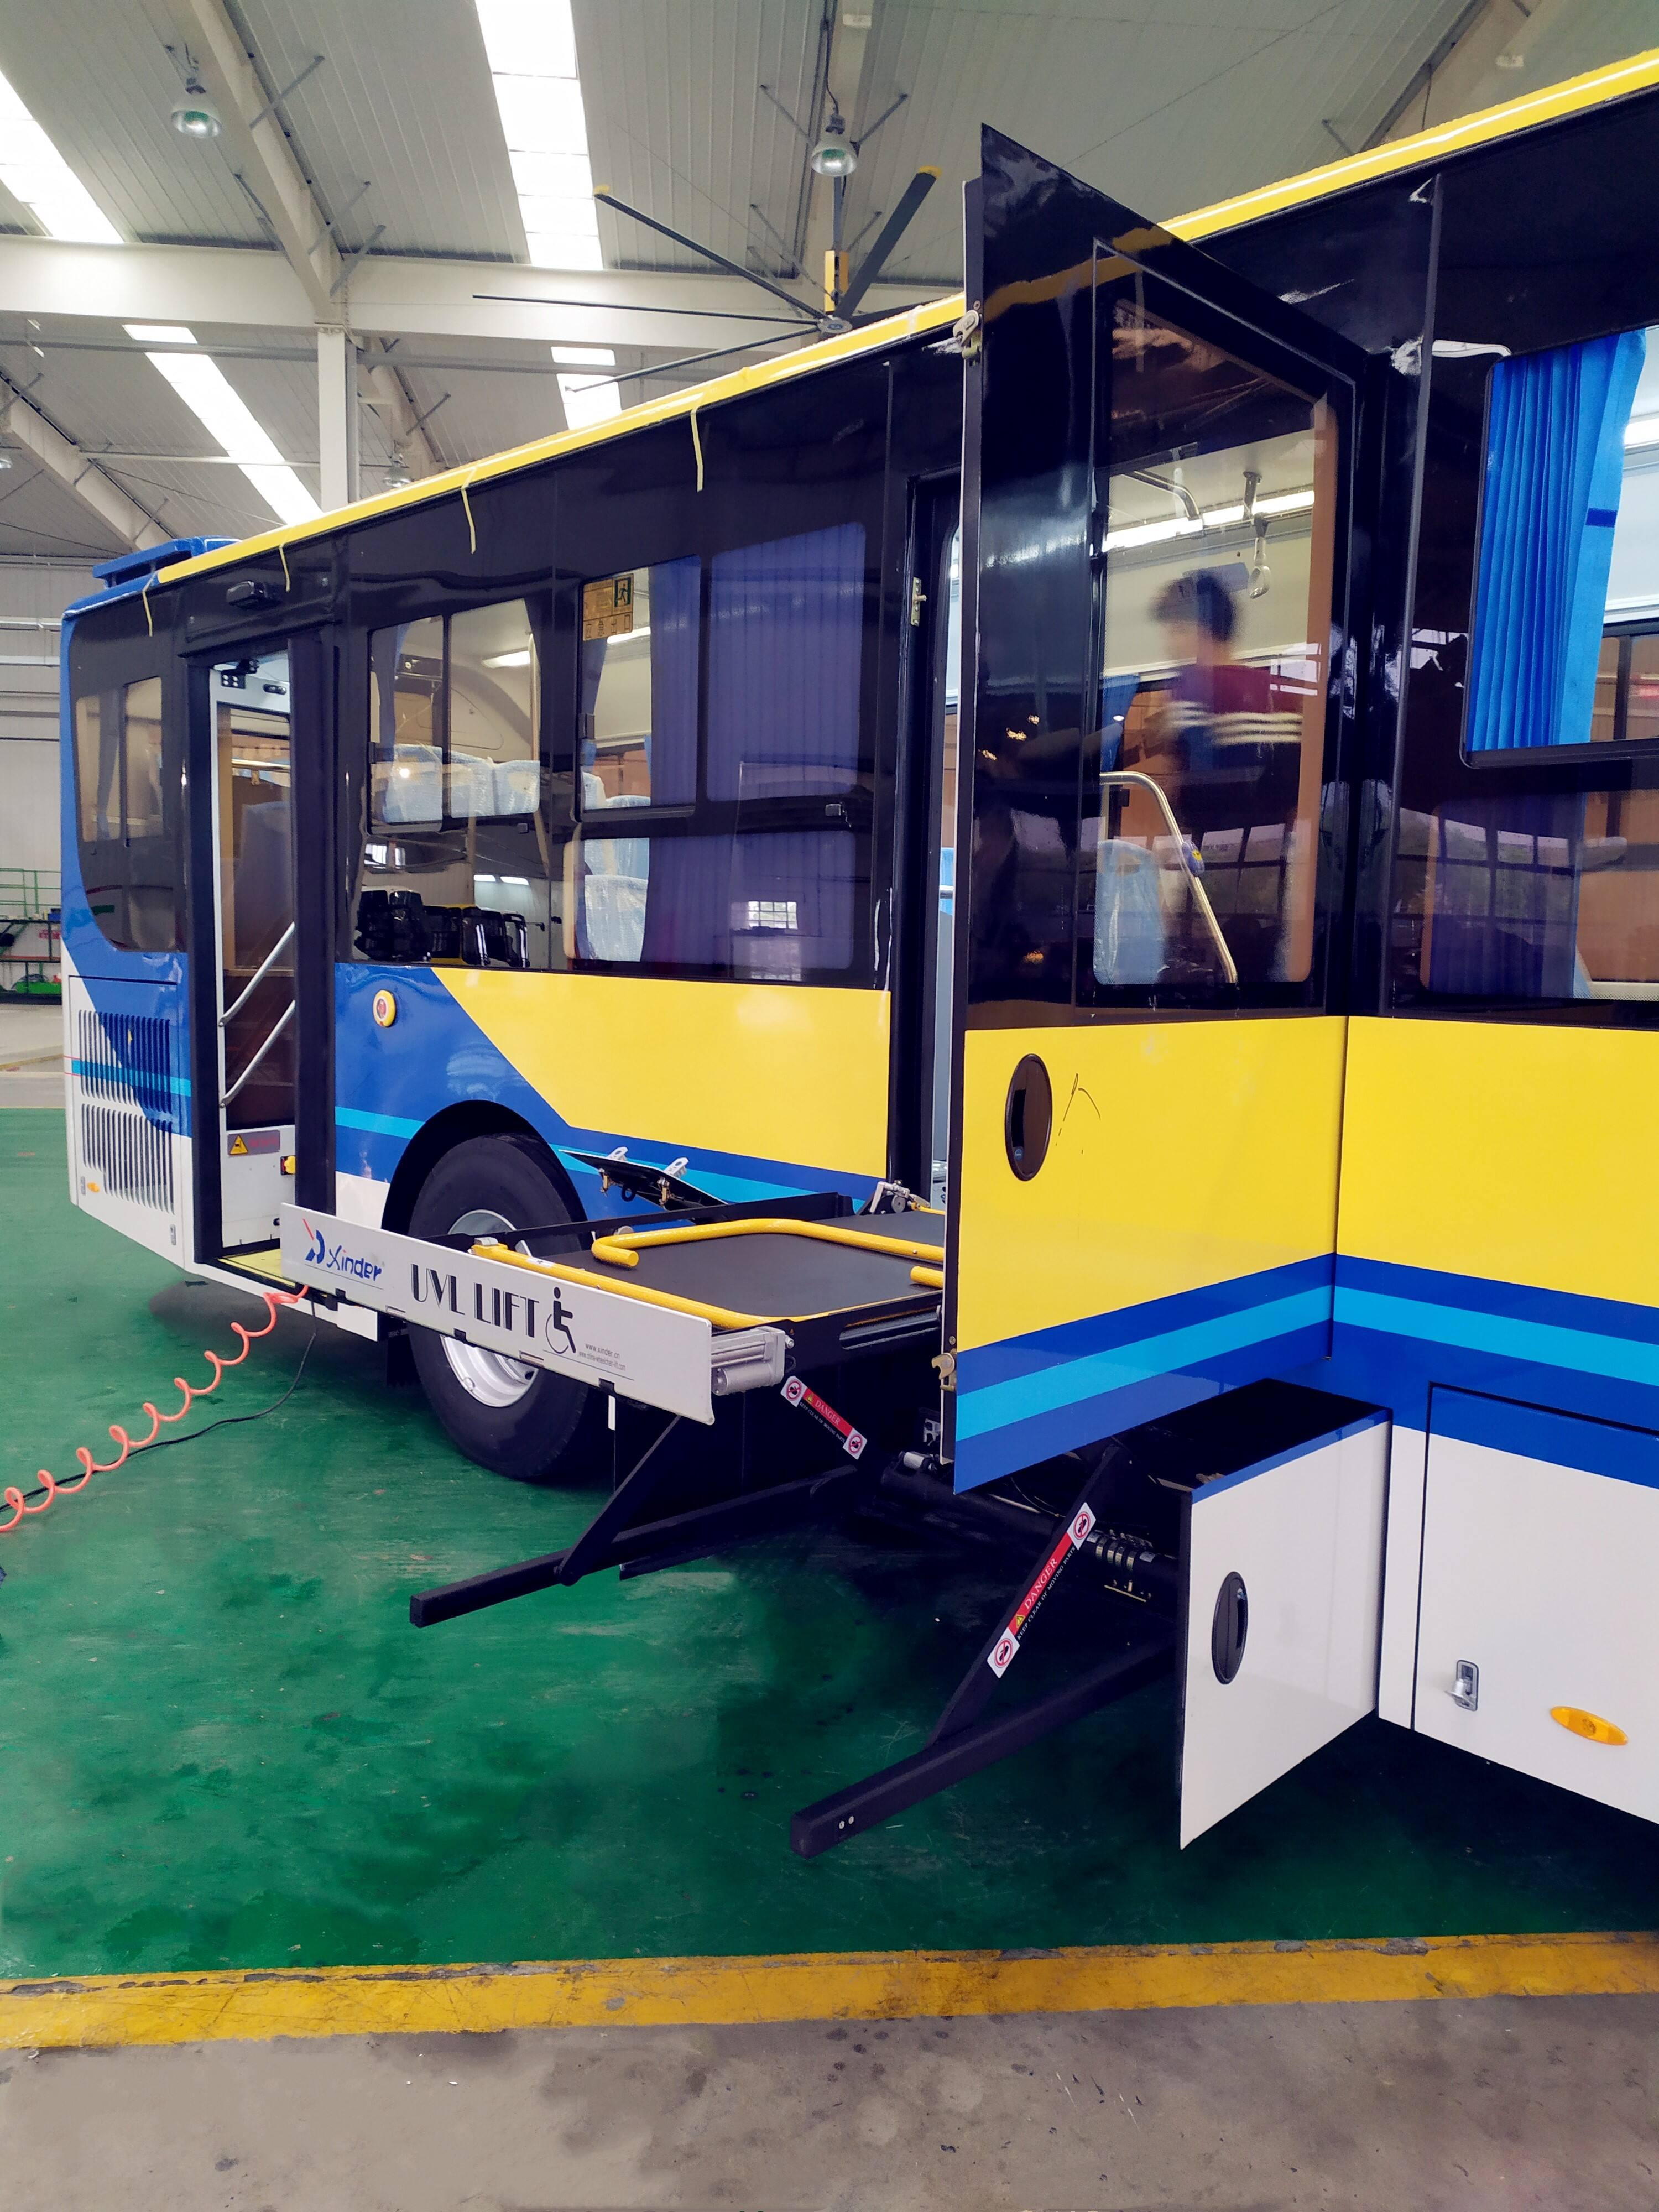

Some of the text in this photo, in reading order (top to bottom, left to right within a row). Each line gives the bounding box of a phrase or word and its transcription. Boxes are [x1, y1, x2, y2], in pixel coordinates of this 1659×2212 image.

[410, 1263, 540, 1338] UVL LIFT
[808, 1409, 818, 1420] CLEAR
[815, 1400, 841, 1425] DANGER
[1017, 1546, 1076, 1641] KEEP CLEAR OF MOVING PARTS
[1024, 1558, 1057, 1609] DANGER
